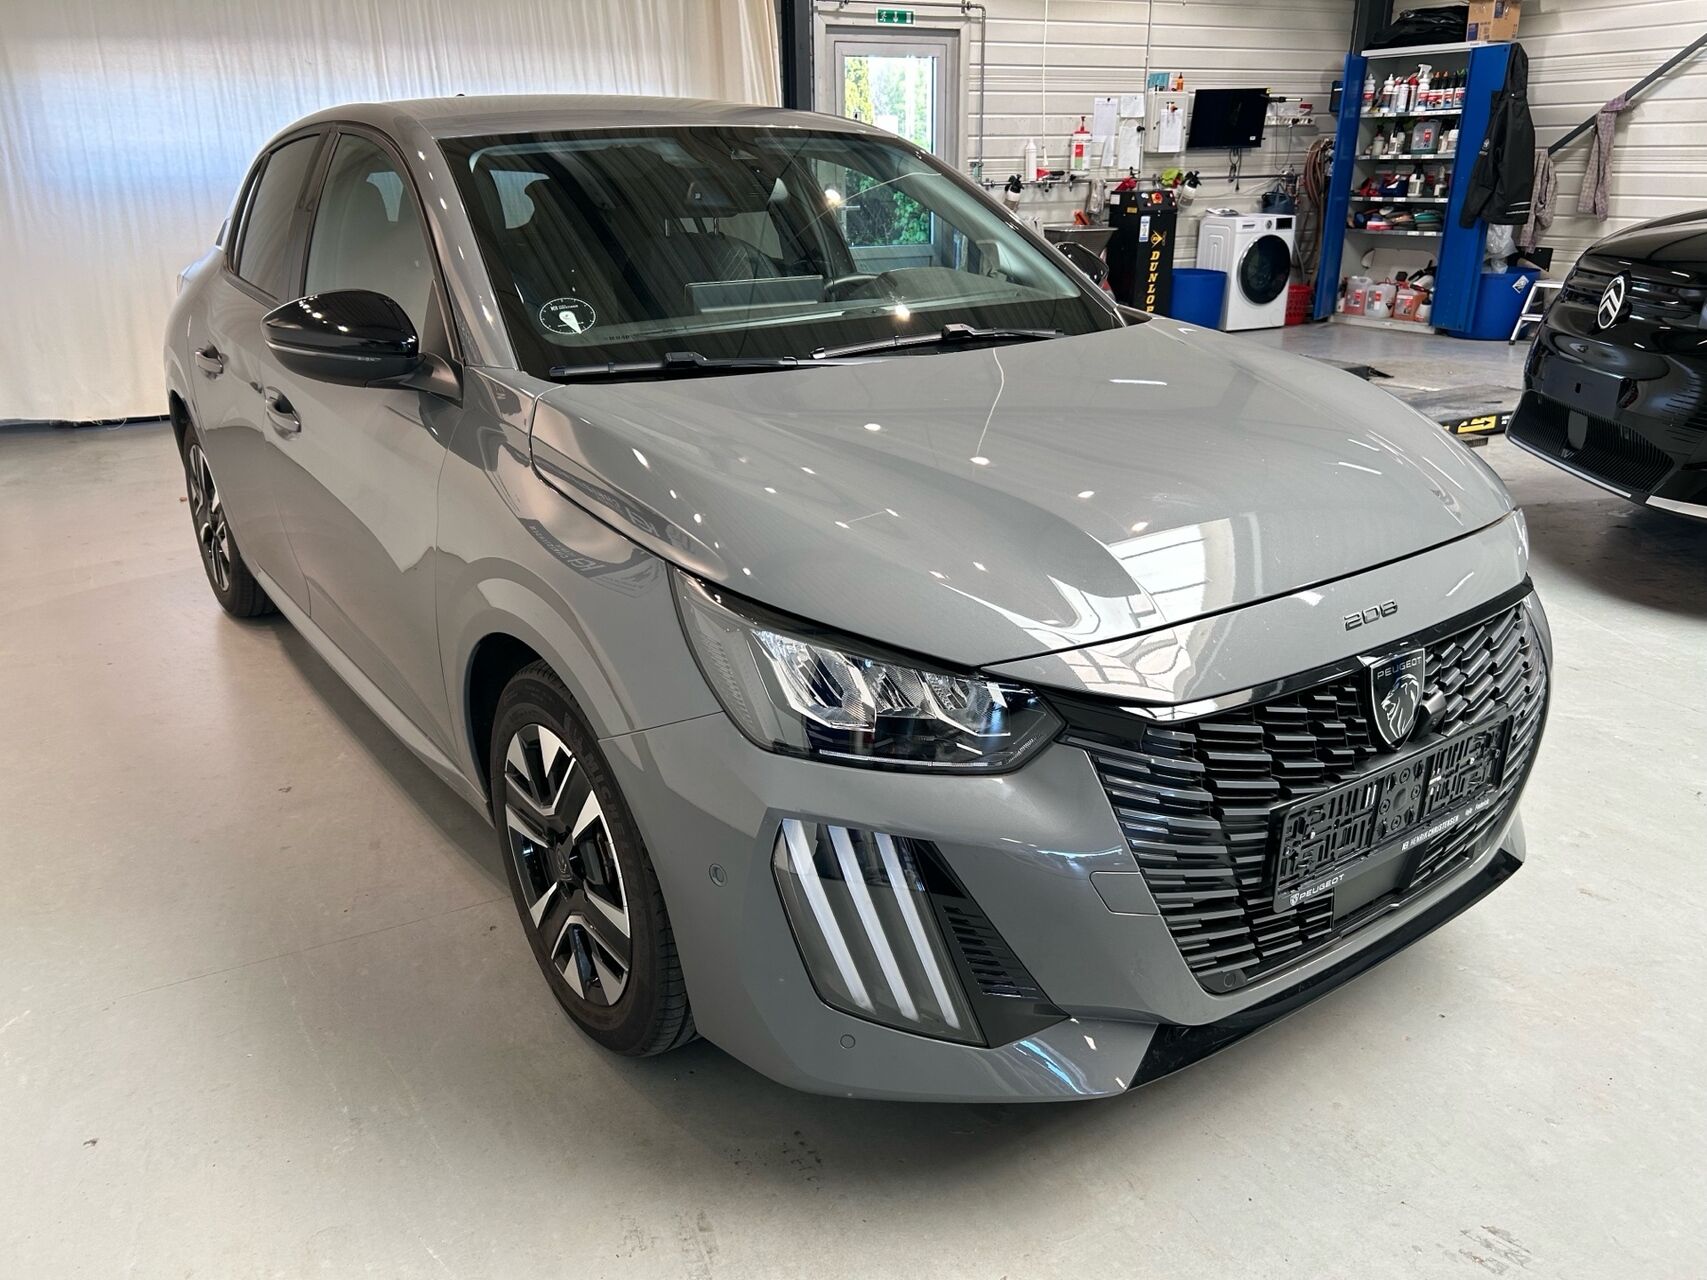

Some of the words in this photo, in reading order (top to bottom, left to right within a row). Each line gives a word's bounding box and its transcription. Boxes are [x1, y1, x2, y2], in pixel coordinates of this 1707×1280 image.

[1146, 250, 1160, 313] DUNLOP
[1343, 600, 1398, 631] 208
[1377, 656, 1422, 679] PEUGEOT
[1299, 873, 1344, 900] PEUGEOT
